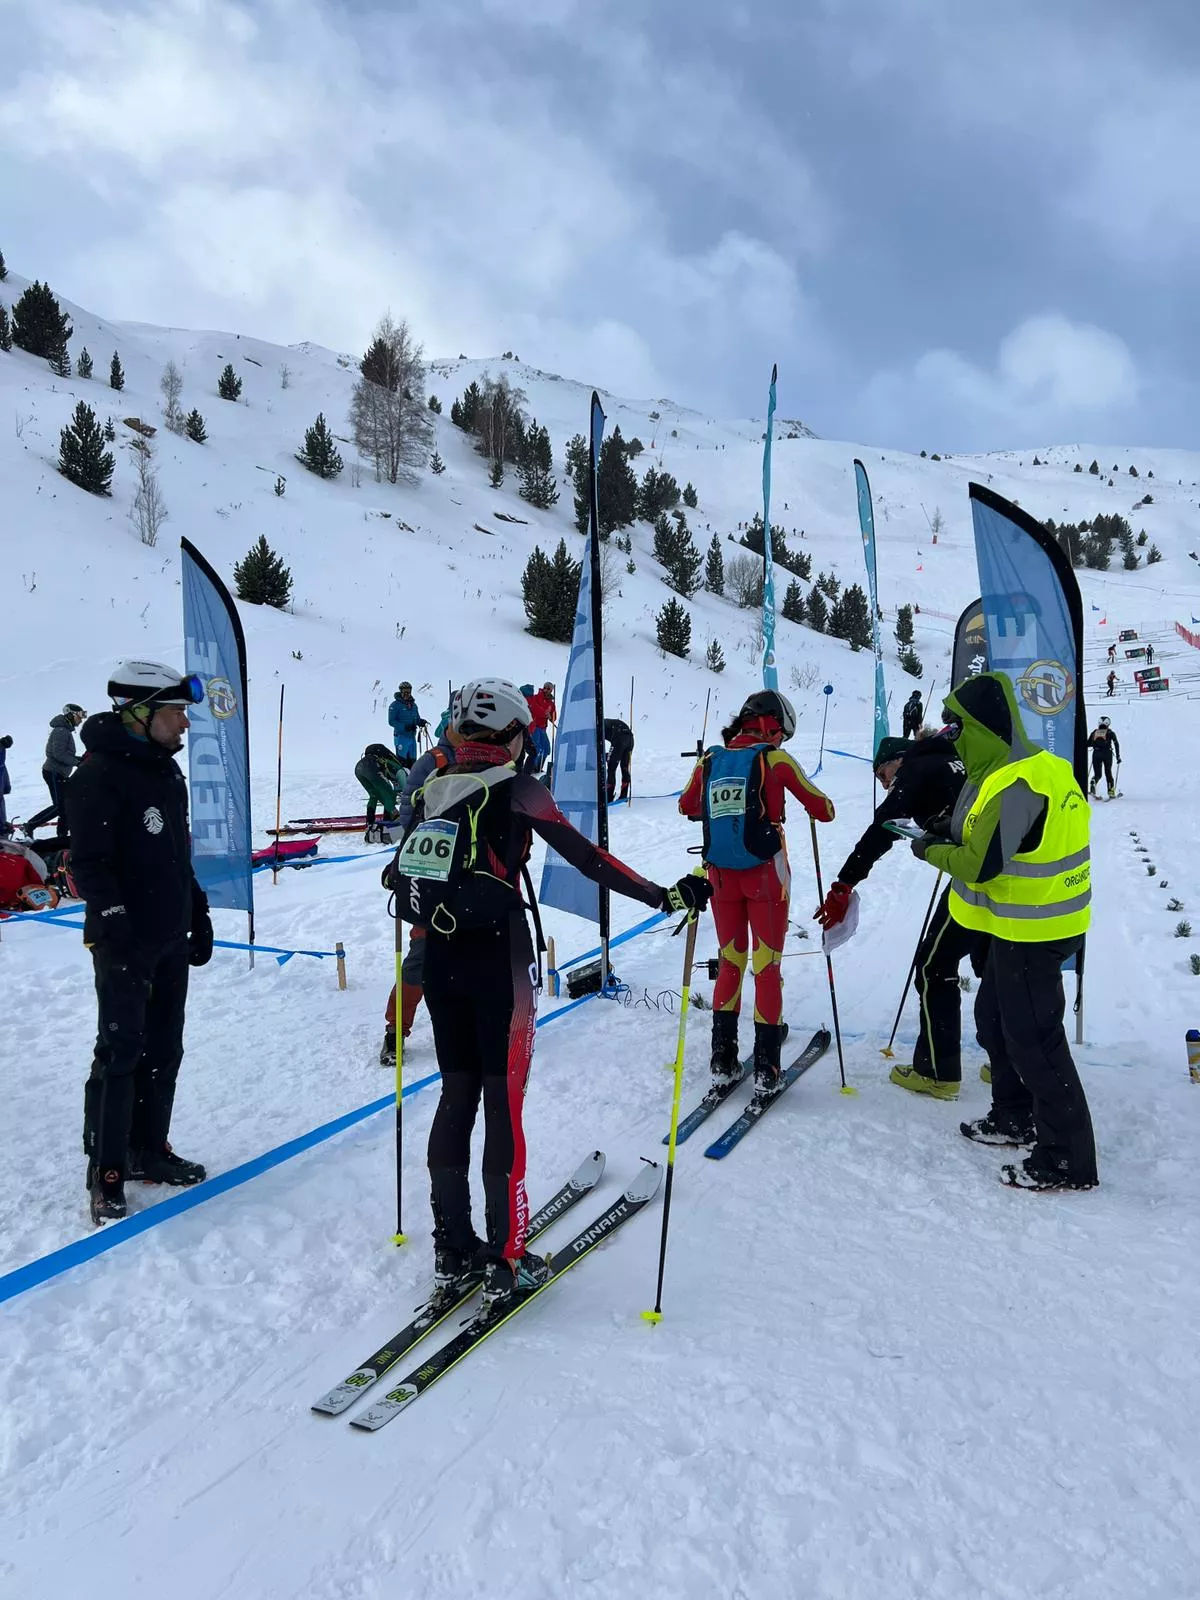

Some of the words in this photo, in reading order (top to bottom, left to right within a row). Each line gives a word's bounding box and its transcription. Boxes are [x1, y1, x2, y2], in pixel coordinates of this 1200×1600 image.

[712, 789, 742, 804] 107
[405, 836, 451, 859] 106
[572, 1201, 629, 1254] DYNAFIT
[345, 1372, 375, 1387] 64
[385, 1387, 416, 1403] 64
